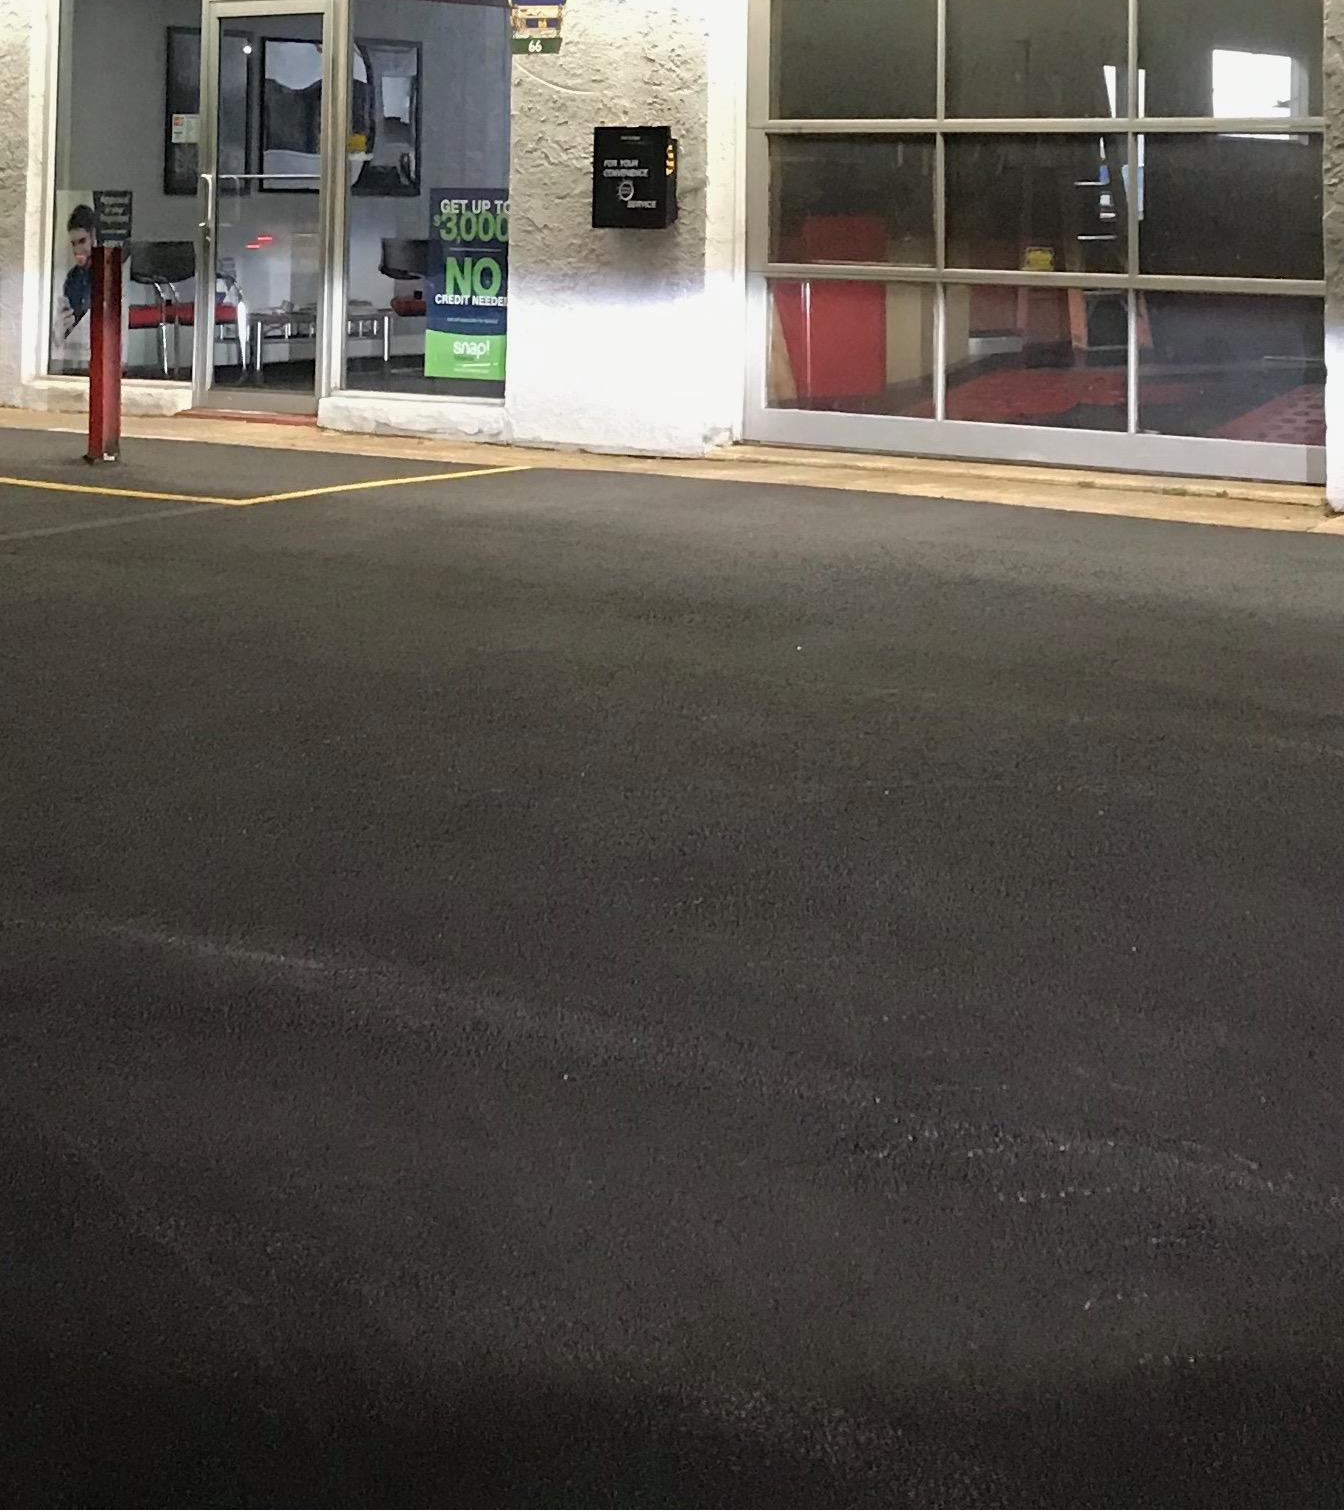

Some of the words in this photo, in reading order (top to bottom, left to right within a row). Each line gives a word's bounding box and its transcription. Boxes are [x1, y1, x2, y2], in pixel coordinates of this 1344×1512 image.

[528, 39, 544, 53] 66
[440, 199, 469, 214] GET
[472, 199, 491, 215] UP
[444, 255, 502, 297] NO
[434, 293, 470, 305] CREDIT
